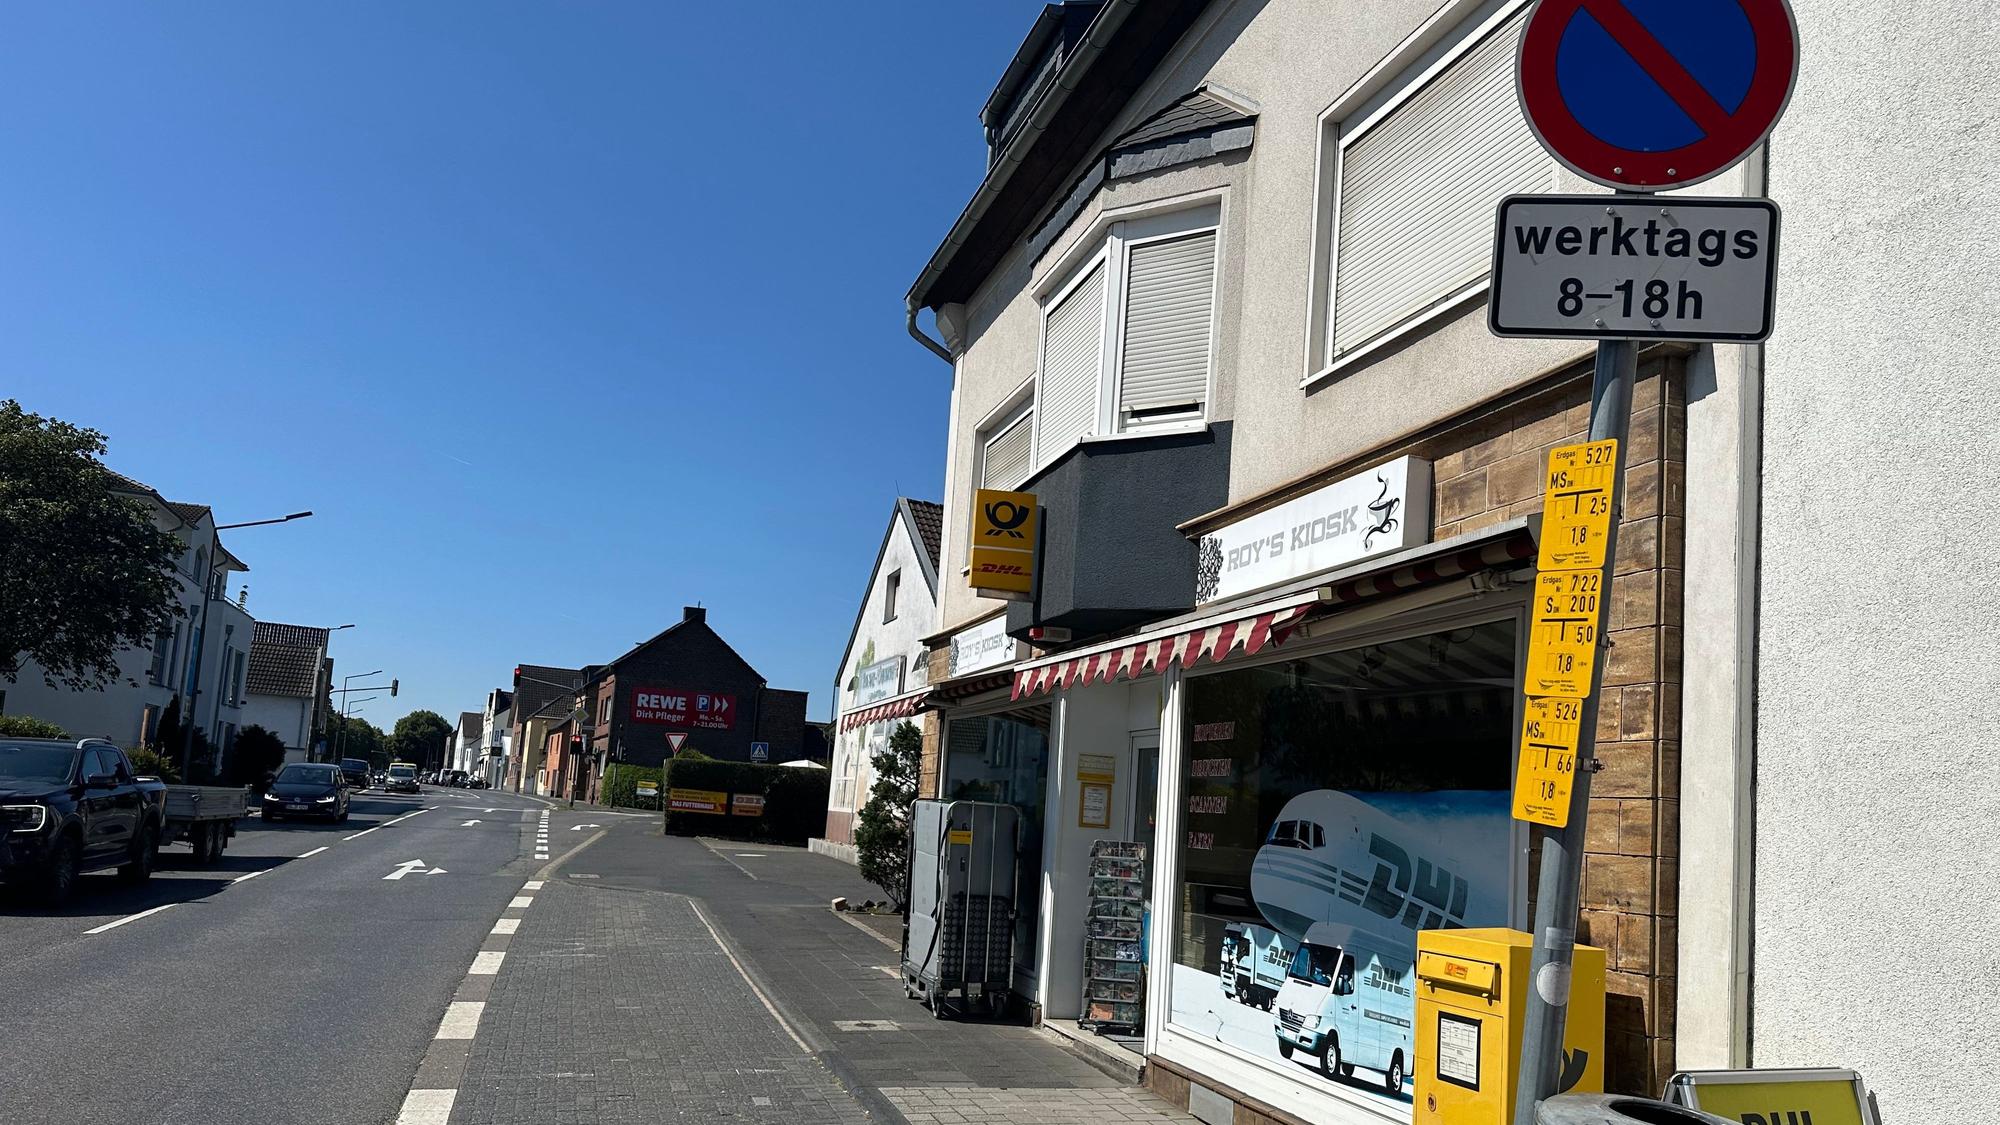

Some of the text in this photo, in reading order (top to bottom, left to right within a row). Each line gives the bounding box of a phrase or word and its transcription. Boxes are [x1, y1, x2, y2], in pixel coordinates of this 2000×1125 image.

[1514, 217, 1758, 267] werktags
[1557, 278, 1703, 319] 8–18h
[1556, 446, 1612, 464] Erdgas 527
[1550, 472, 1567, 489] MS
[1590, 497, 1607, 516] 2,5
[1227, 505, 1358, 572] ROY'S KIOSK
[1571, 527, 1587, 546] 1,8
[981, 563, 1024, 576] DHL
[1543, 575, 1598, 592] Erdgas 722
[1570, 596, 1595, 612] 200
[982, 632, 1004, 653] KIOSK
[1577, 625, 1593, 645] 5,0
[1558, 654, 1573, 674] 1,8
[637, 694, 687, 711] REWE
[1556, 703, 1577, 720] 526
[636, 710, 685, 723] Dirk Pfleger
[1526, 721, 1540, 738] MS
[1557, 754, 1571, 774] 6,6
[1541, 781, 1555, 801] 1,8
[1362, 832, 1469, 930] DHL
[1370, 963, 1404, 996] DHL
